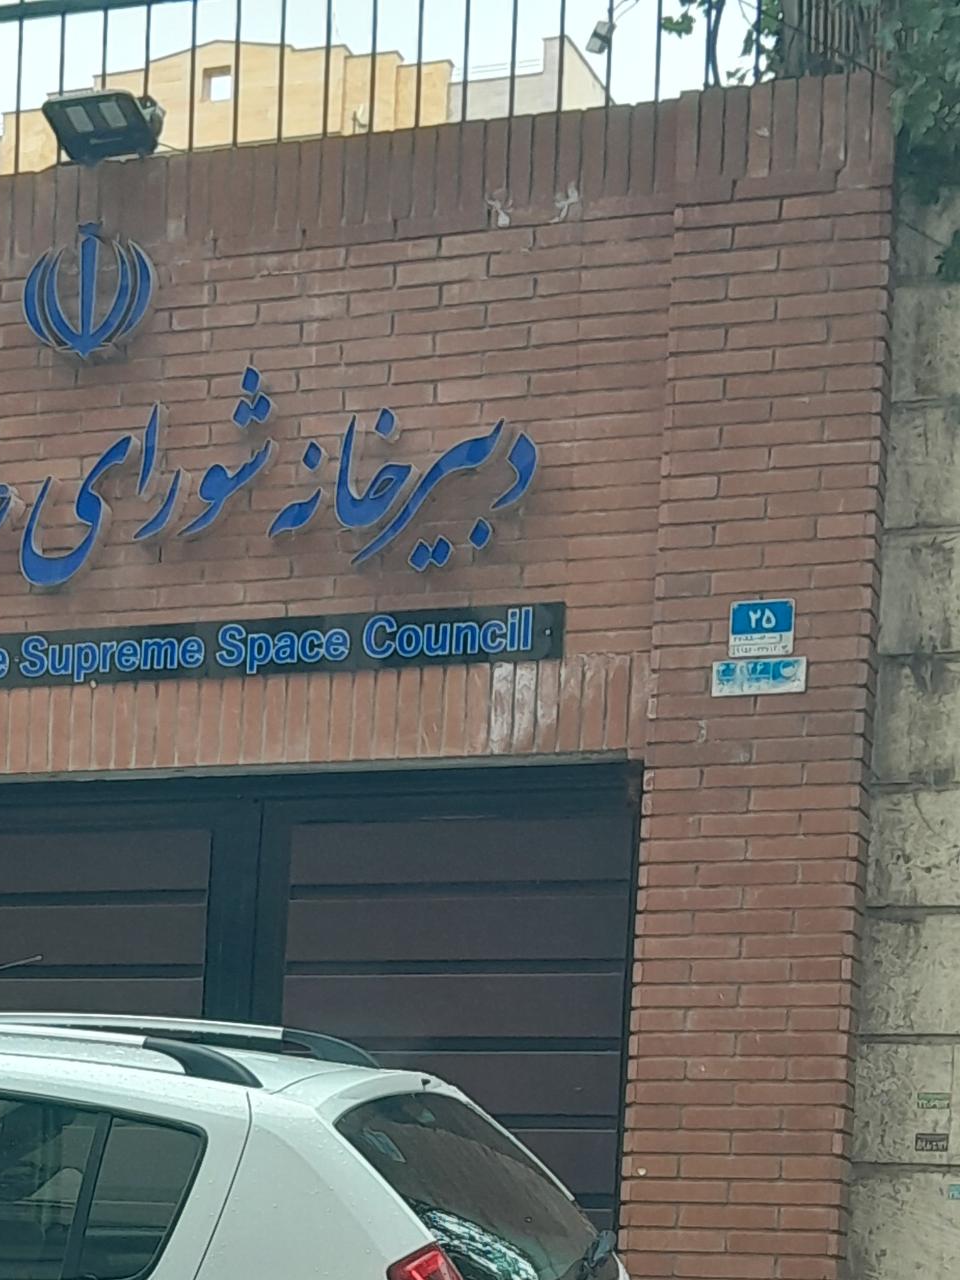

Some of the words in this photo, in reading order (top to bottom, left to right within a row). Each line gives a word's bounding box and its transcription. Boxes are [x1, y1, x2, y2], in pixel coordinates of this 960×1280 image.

[19, 366, 273, 587] شورای
[268, 406, 538, 572] دبیرخانه
[19, 631, 205, 684] Supreme
[215, 622, 351, 675] Space
[362, 605, 534, 659] Council
[748, 608, 777, 629] ۲۵
